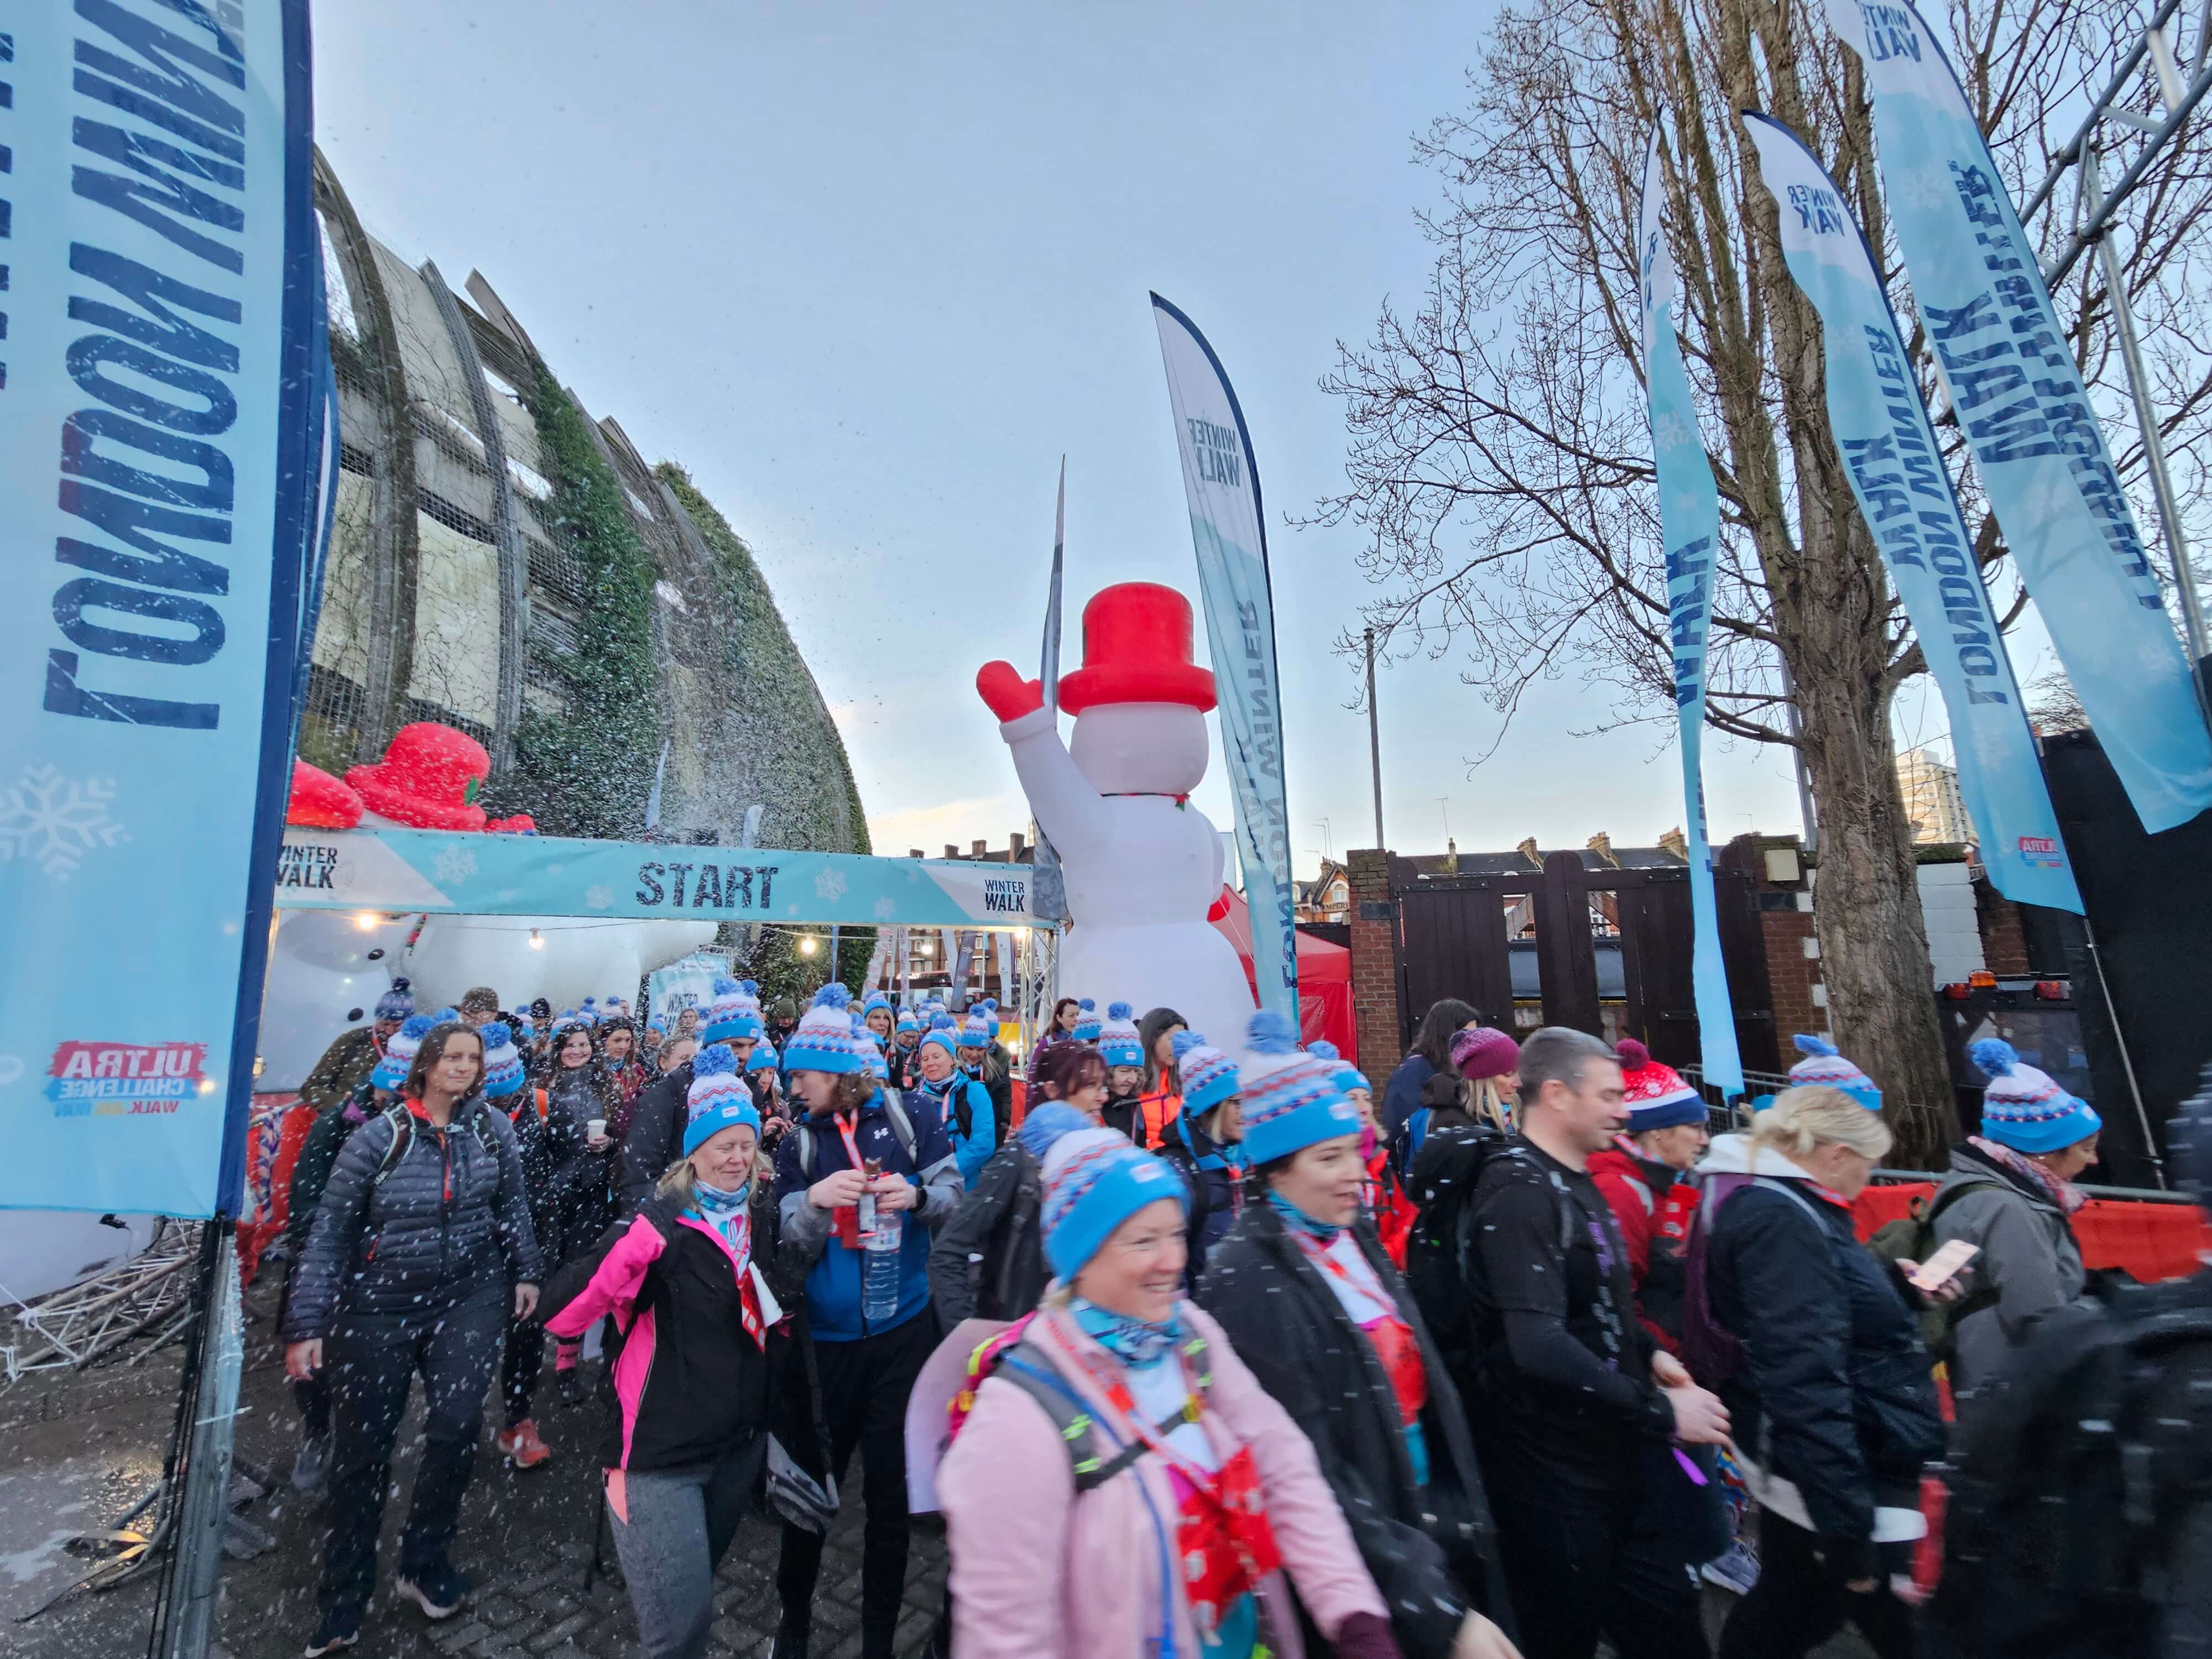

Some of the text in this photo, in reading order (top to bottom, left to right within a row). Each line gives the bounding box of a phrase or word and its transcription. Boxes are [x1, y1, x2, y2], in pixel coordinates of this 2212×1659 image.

[637, 862, 779, 909] START
[984, 879, 1025, 894] WINTER
[985, 893, 1025, 912] WALK
